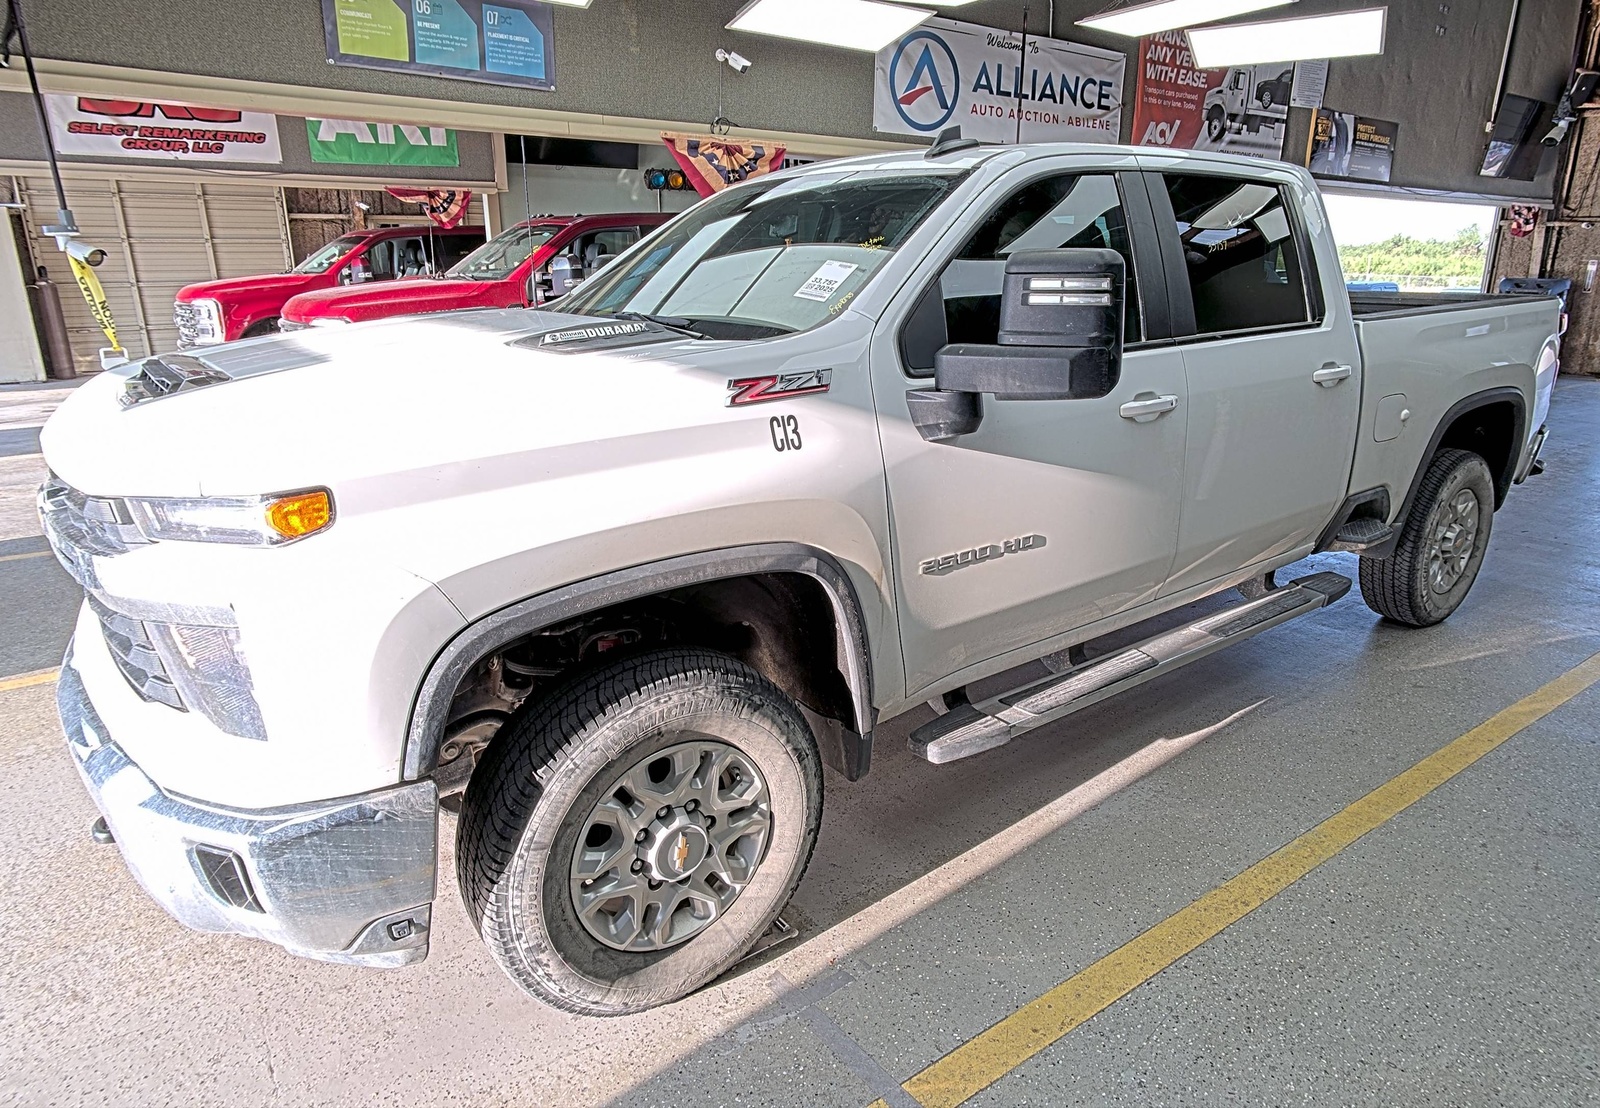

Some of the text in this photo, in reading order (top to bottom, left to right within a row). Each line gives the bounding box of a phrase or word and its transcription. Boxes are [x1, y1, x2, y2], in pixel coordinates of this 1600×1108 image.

[340, 10, 372, 19] COMMUNICATE
[416, 0, 430, 14] 06
[487, 10, 498, 25] 07
[488, 32, 508, 40] PLACEMENT
[513, 35, 530, 43] CRITICAL
[1029, 41, 1039, 54] To
[1146, 44, 1174, 63] ANY
[1146, 63, 1208, 88] WITH EASE.
[972, 61, 1113, 111] ALLIANCE
[1144, 85, 1165, 95] Transport
[1176, 92, 1198, 100] purchased
[1148, 96, 1157, 104] this
[1172, 100, 1182, 108] lane.
[970, 104, 1003, 117] AUTO
[1008, 108, 1059, 124] AUCTION
[1067, 116, 1110, 130] ABILENE
[68, 121, 266, 144] SELECT REMARKETING
[1140, 120, 1181, 145] ACV
[1356, 132, 1370, 141] EVERY
[1357, 124, 1376, 134] PROTECT
[122, 138, 224, 154] GROUP, LLC
[560, 331, 584, 339] Allison
[586, 323, 650, 338] DURAMAX
[725, 367, 832, 408] Z71
[918, 534, 1047, 576] 2500 HD
